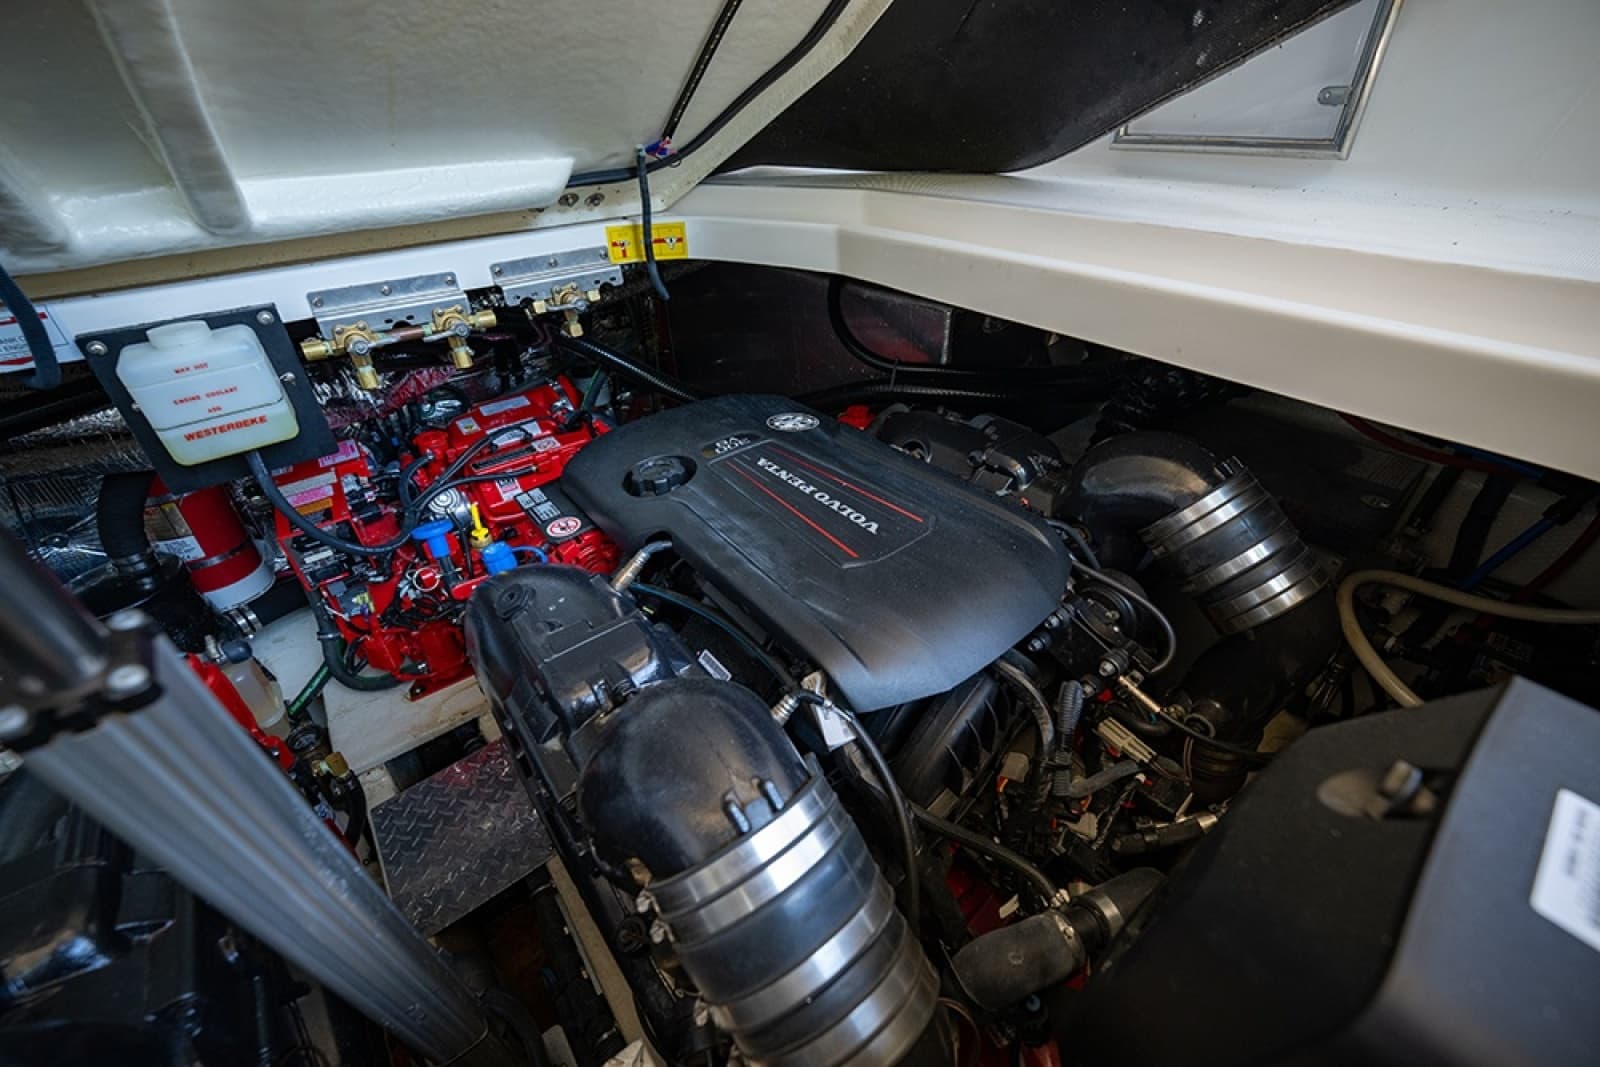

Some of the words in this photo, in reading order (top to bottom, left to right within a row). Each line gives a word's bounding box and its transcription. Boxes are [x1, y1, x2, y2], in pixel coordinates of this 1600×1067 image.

[173, 395, 201, 405] ENGINE
[206, 386, 238, 398] COOLANT
[183, 416, 267, 440] WESTERBEKE
[757, 457, 817, 494] PENTA
[813, 492, 879, 535] VOLVO
